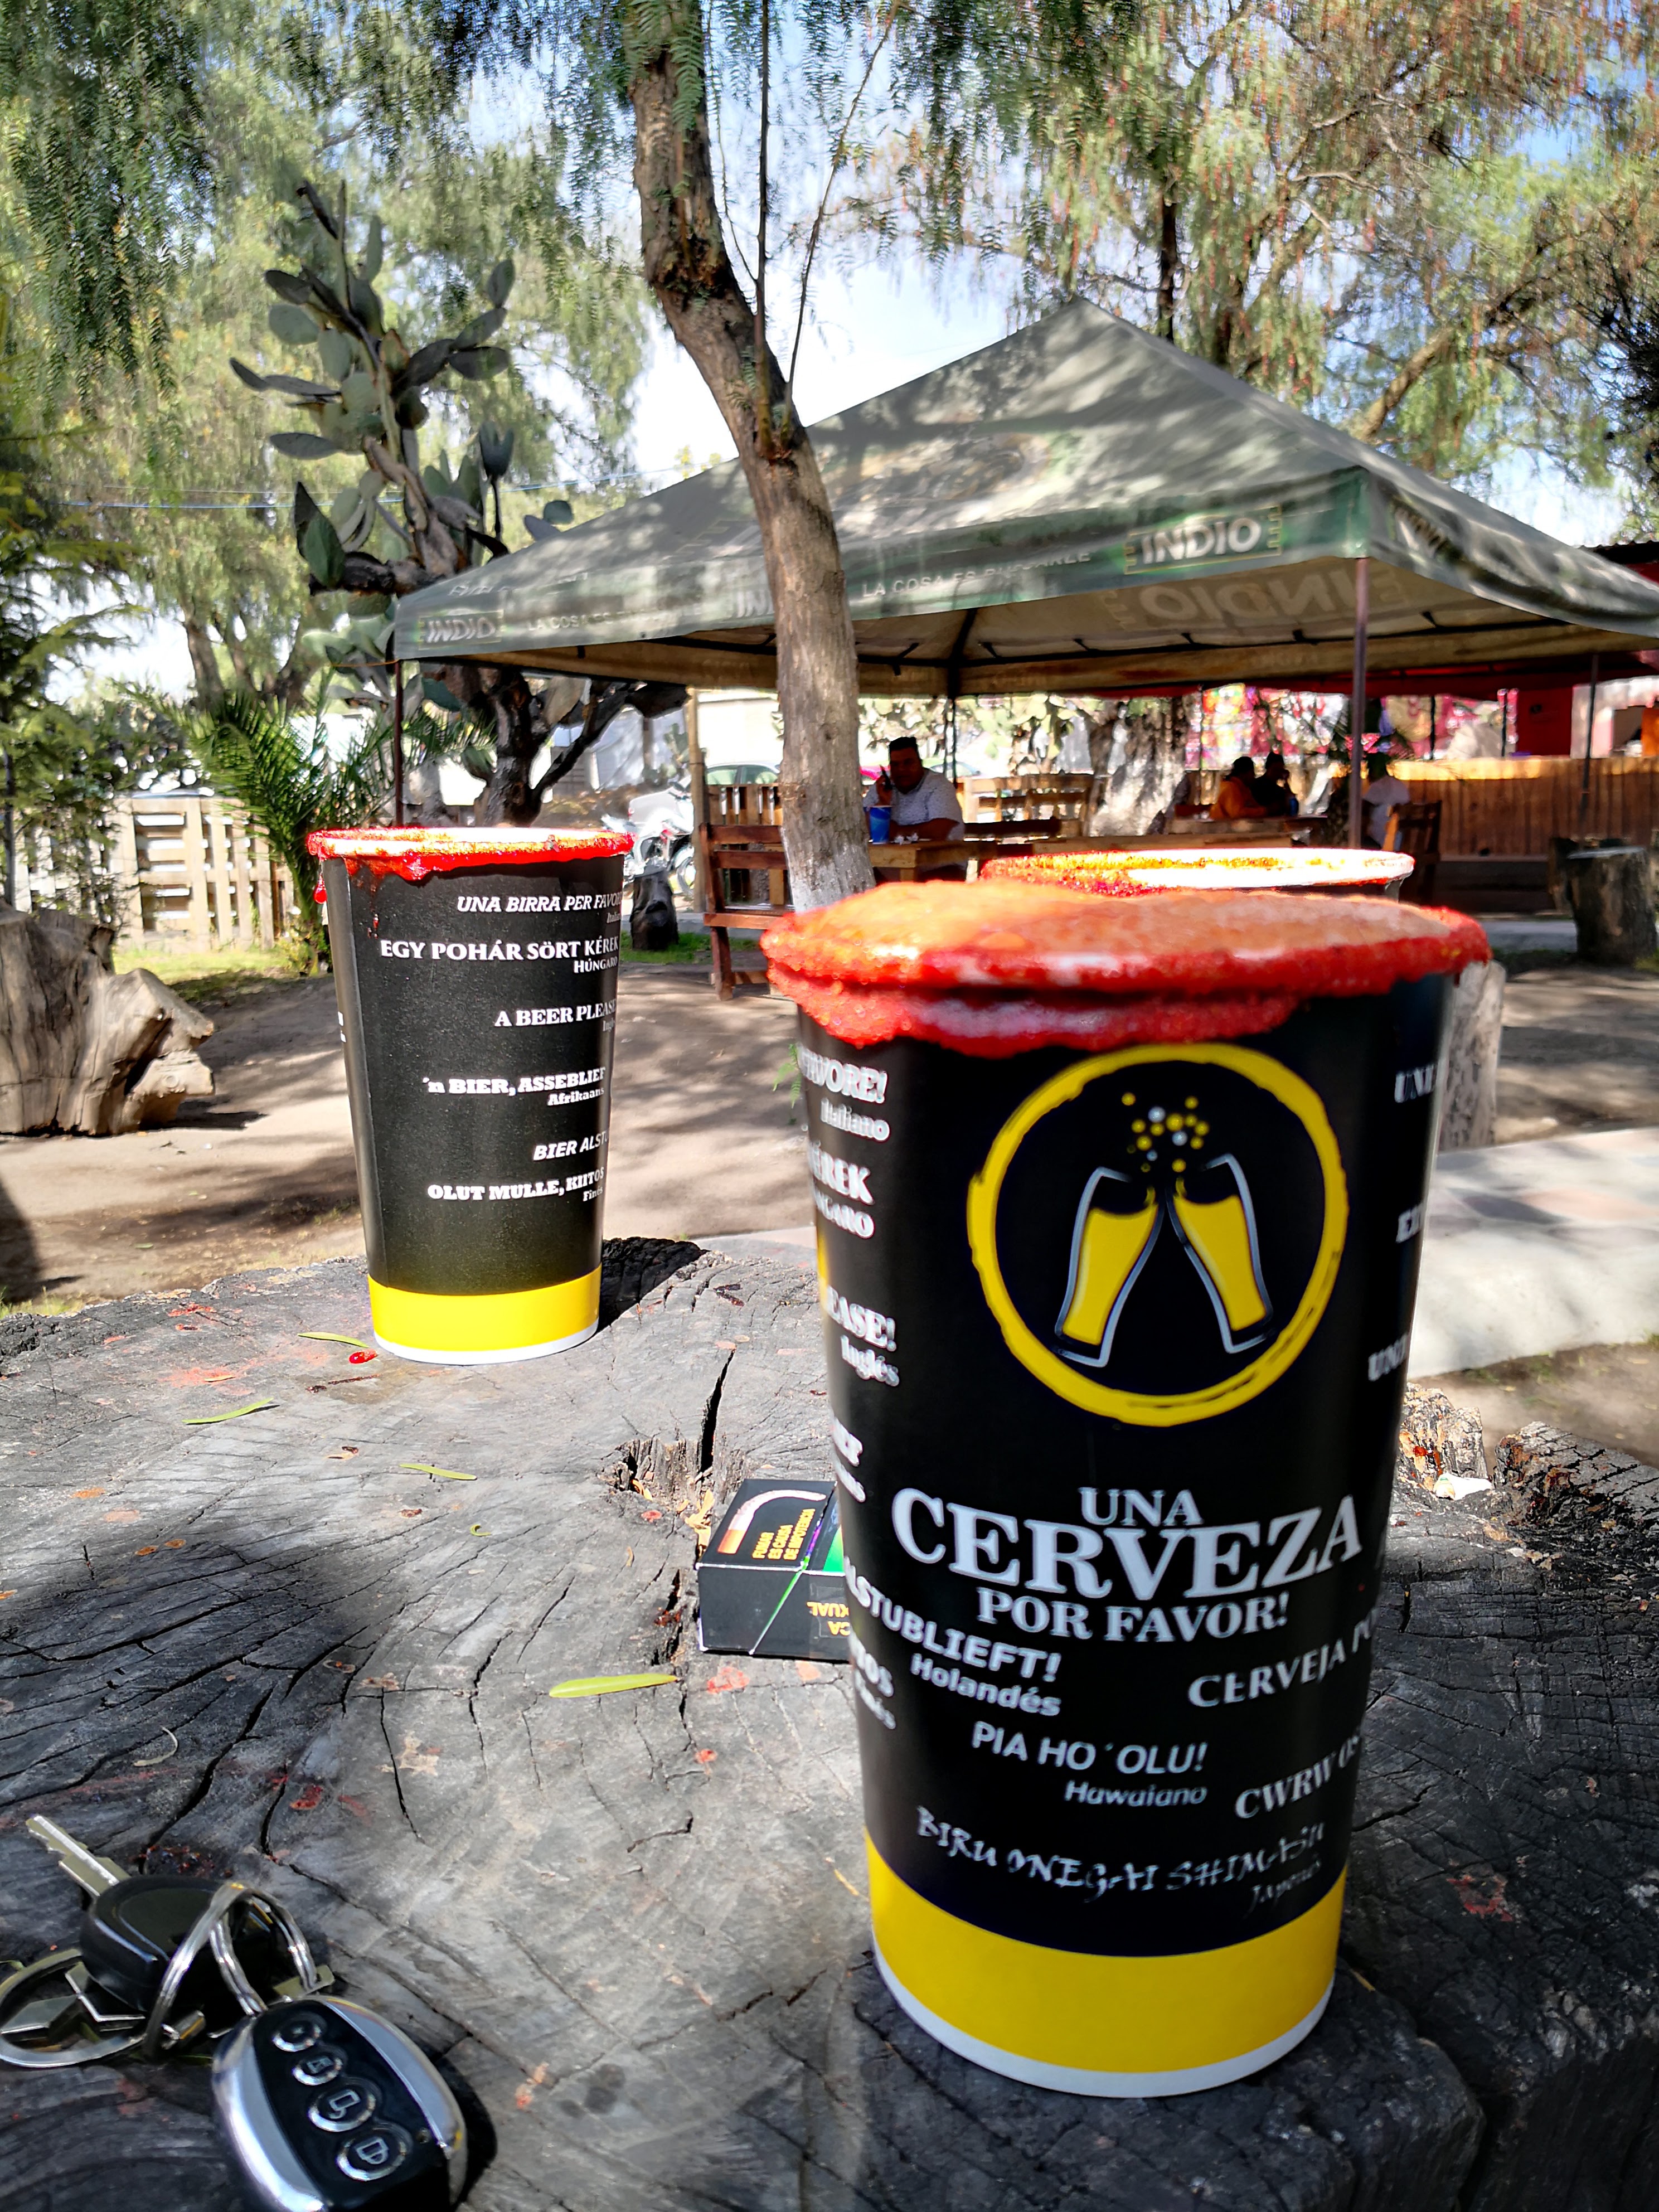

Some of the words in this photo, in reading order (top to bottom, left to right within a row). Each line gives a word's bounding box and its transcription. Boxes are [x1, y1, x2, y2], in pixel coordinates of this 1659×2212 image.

[1141, 517, 1262, 564] INDIO
[735, 589, 774, 619] IN
[426, 617, 496, 643] INDIO
[457, 896, 502, 913] UNA
[506, 896, 561, 913] BIRRA
[563, 894, 592, 911] PER
[380, 939, 426, 959] EGY
[431, 939, 525, 961] POHÁR
[526, 940, 581, 960] SÖRT
[584, 934, 619, 957] KÉREK
[573, 955, 618, 973] HÚNGARO
[494, 1010, 513, 1027] A
[516, 1007, 574, 1026] BEER
[448, 1078, 517, 1097] BIER,
[517, 1066, 606, 1093] ASSEBLIEF
[547, 1088, 605, 1107] Afrikaans
[820, 1097, 891, 1141] Italiano
[532, 1139, 578, 1161] BIER
[427, 1184, 486, 1200] OLUT
[488, 1180, 565, 1200] MULLE,
[565, 1166, 605, 1192] KIITOS
[583, 1186, 604, 1202] Finés
[1078, 1486, 1204, 1527] UNA
[772, 1524, 794, 1549] CAUSA
[788, 1508, 816, 1549] IMPOTENCIA
[752, 1531, 775, 1559] FUMAR
[767, 1548, 784, 1559] ES
[783, 1548, 799, 1560] DE
[892, 1487, 1362, 1602] CERVEZA
[976, 1586, 1093, 1640] POR
[1104, 1590, 1290, 1642] FAVOR!
[910, 1653, 1061, 1716] Holandés
[1187, 1637, 1347, 1708] CERVEJA
[971, 1720, 1029, 1762] PIA
[1064, 1779, 1208, 1807] Hawaiano
[1235, 1751, 1337, 1819] CWRW
[916, 1805, 998, 1867] BIRU
